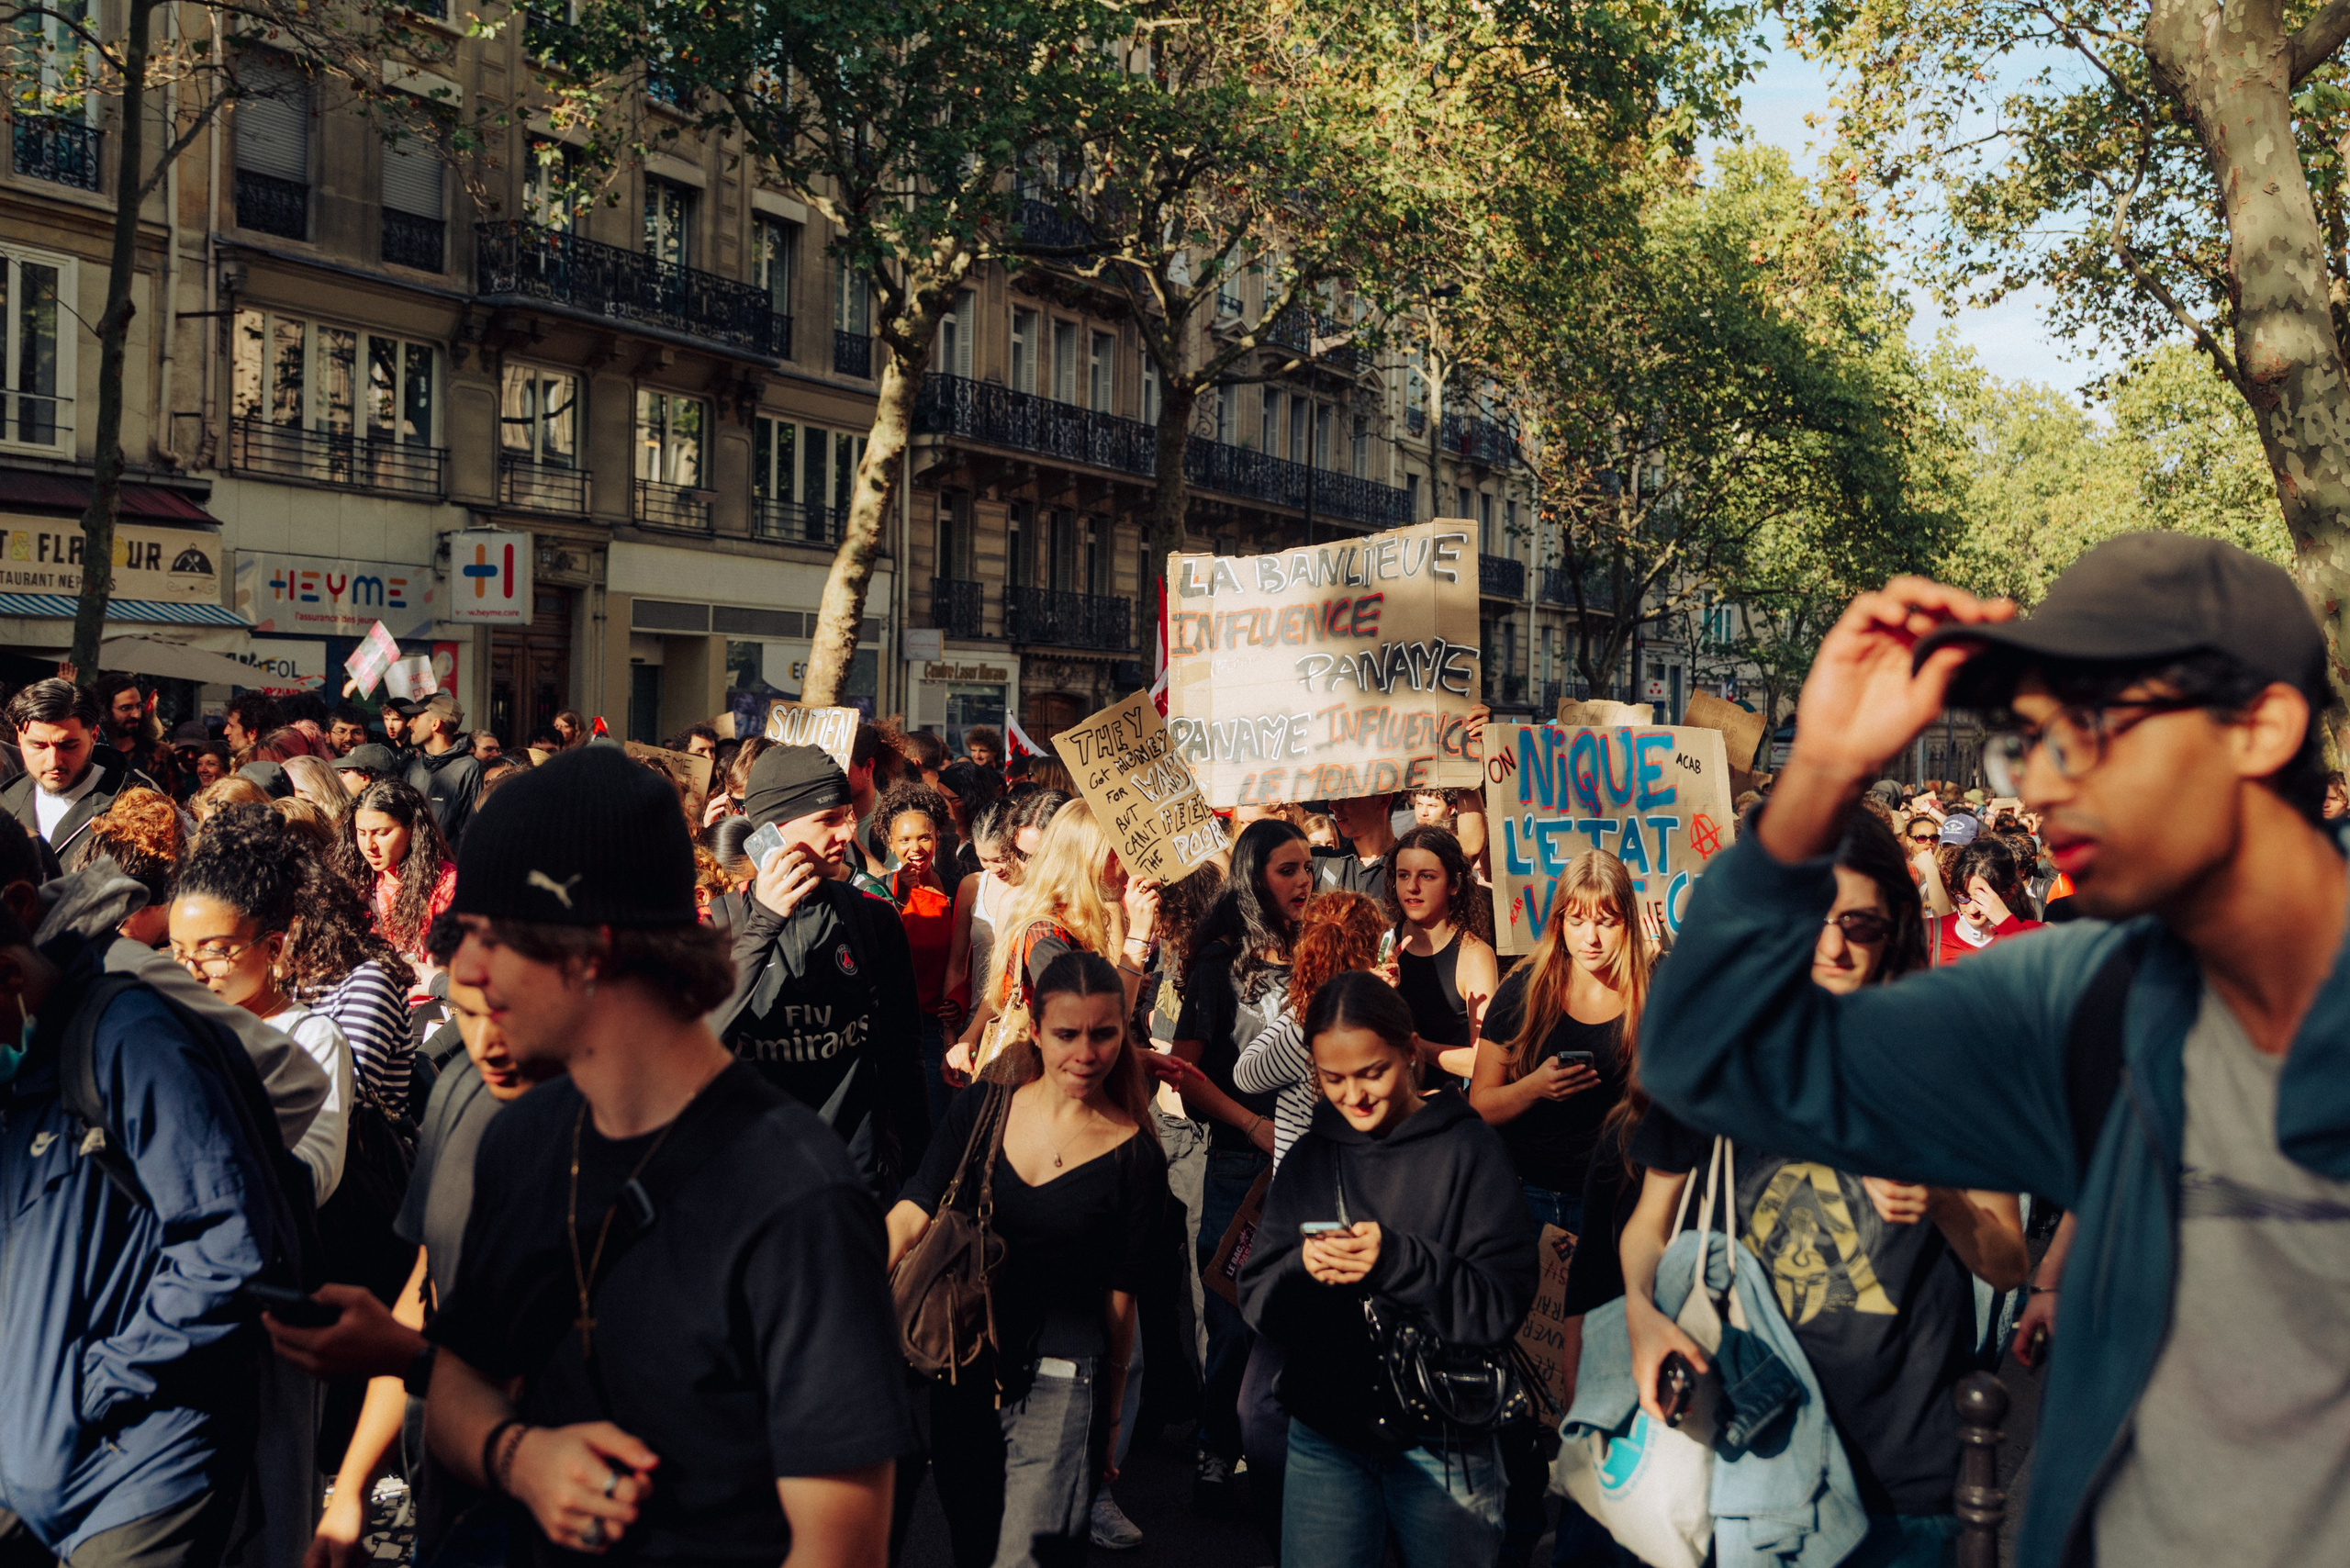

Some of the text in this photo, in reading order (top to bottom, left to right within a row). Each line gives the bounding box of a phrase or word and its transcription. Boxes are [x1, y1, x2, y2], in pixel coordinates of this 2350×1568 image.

[269, 568, 408, 608] HEYME
[1179, 557, 1244, 598] LA
[1169, 592, 1384, 657] INFLUENCE
[1295, 636, 1481, 697] PANAME
[1114, 728, 1167, 777] MONEY
[1170, 702, 1483, 763] PANAME INFLUENCE
[1238, 755, 1436, 806] LE MONDE
[1488, 745, 1517, 784] ON
[1676, 753, 1701, 774] ACAB
[1105, 787, 1128, 804] FOR
[1115, 803, 1137, 836] BUT
[1125, 818, 1158, 856] CAN'T
[1139, 817, 1229, 875] THE POOR
[1505, 812, 1680, 878] L'ETAT
[1509, 897, 1524, 926] ACAB
[784, 1004, 832, 1028] Fly
